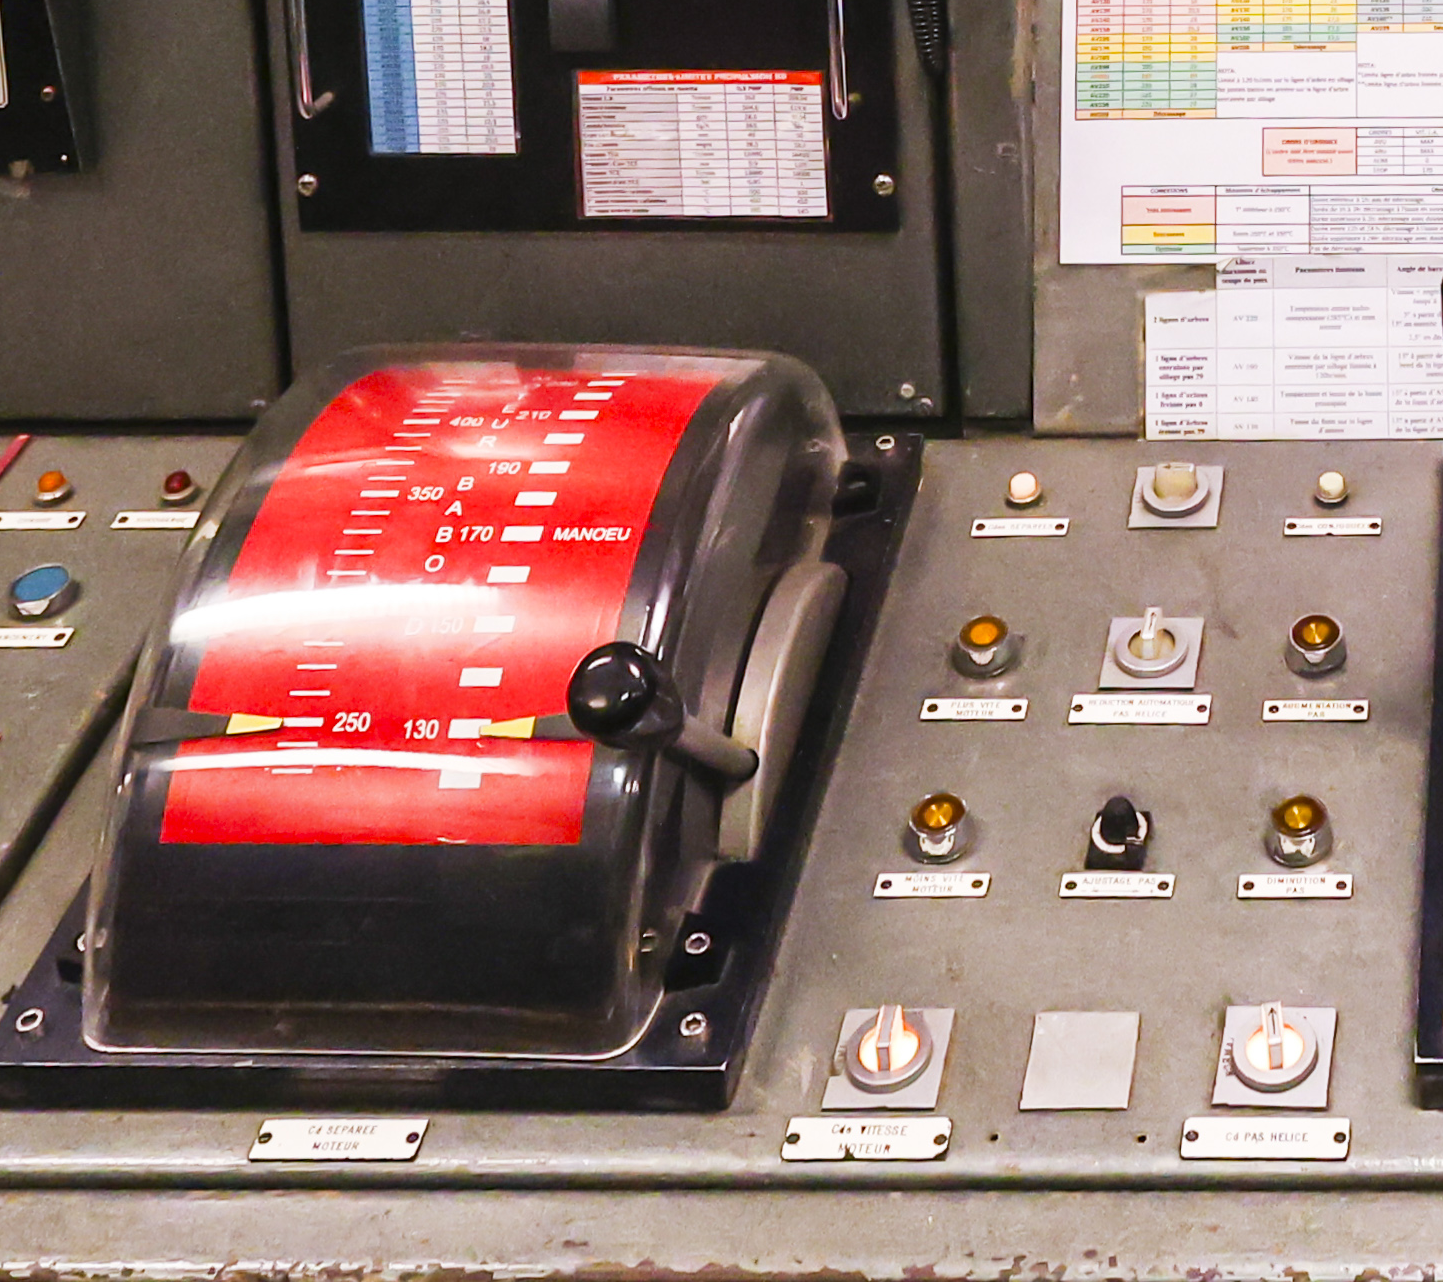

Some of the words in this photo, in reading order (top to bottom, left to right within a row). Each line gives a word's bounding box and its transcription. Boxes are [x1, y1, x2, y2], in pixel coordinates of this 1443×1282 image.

[487, 461, 522, 475] 190
[406, 486, 445, 501] 350
[459, 525, 495, 542] 170
[551, 526, 633, 542] MANOEU
[332, 712, 372, 733] 250
[402, 718, 440, 739] 130
[1244, 1131, 1265, 1142] PAS
[1270, 1131, 1310, 1142] HELICE
[312, 1141, 361, 1151] MOTEUR
